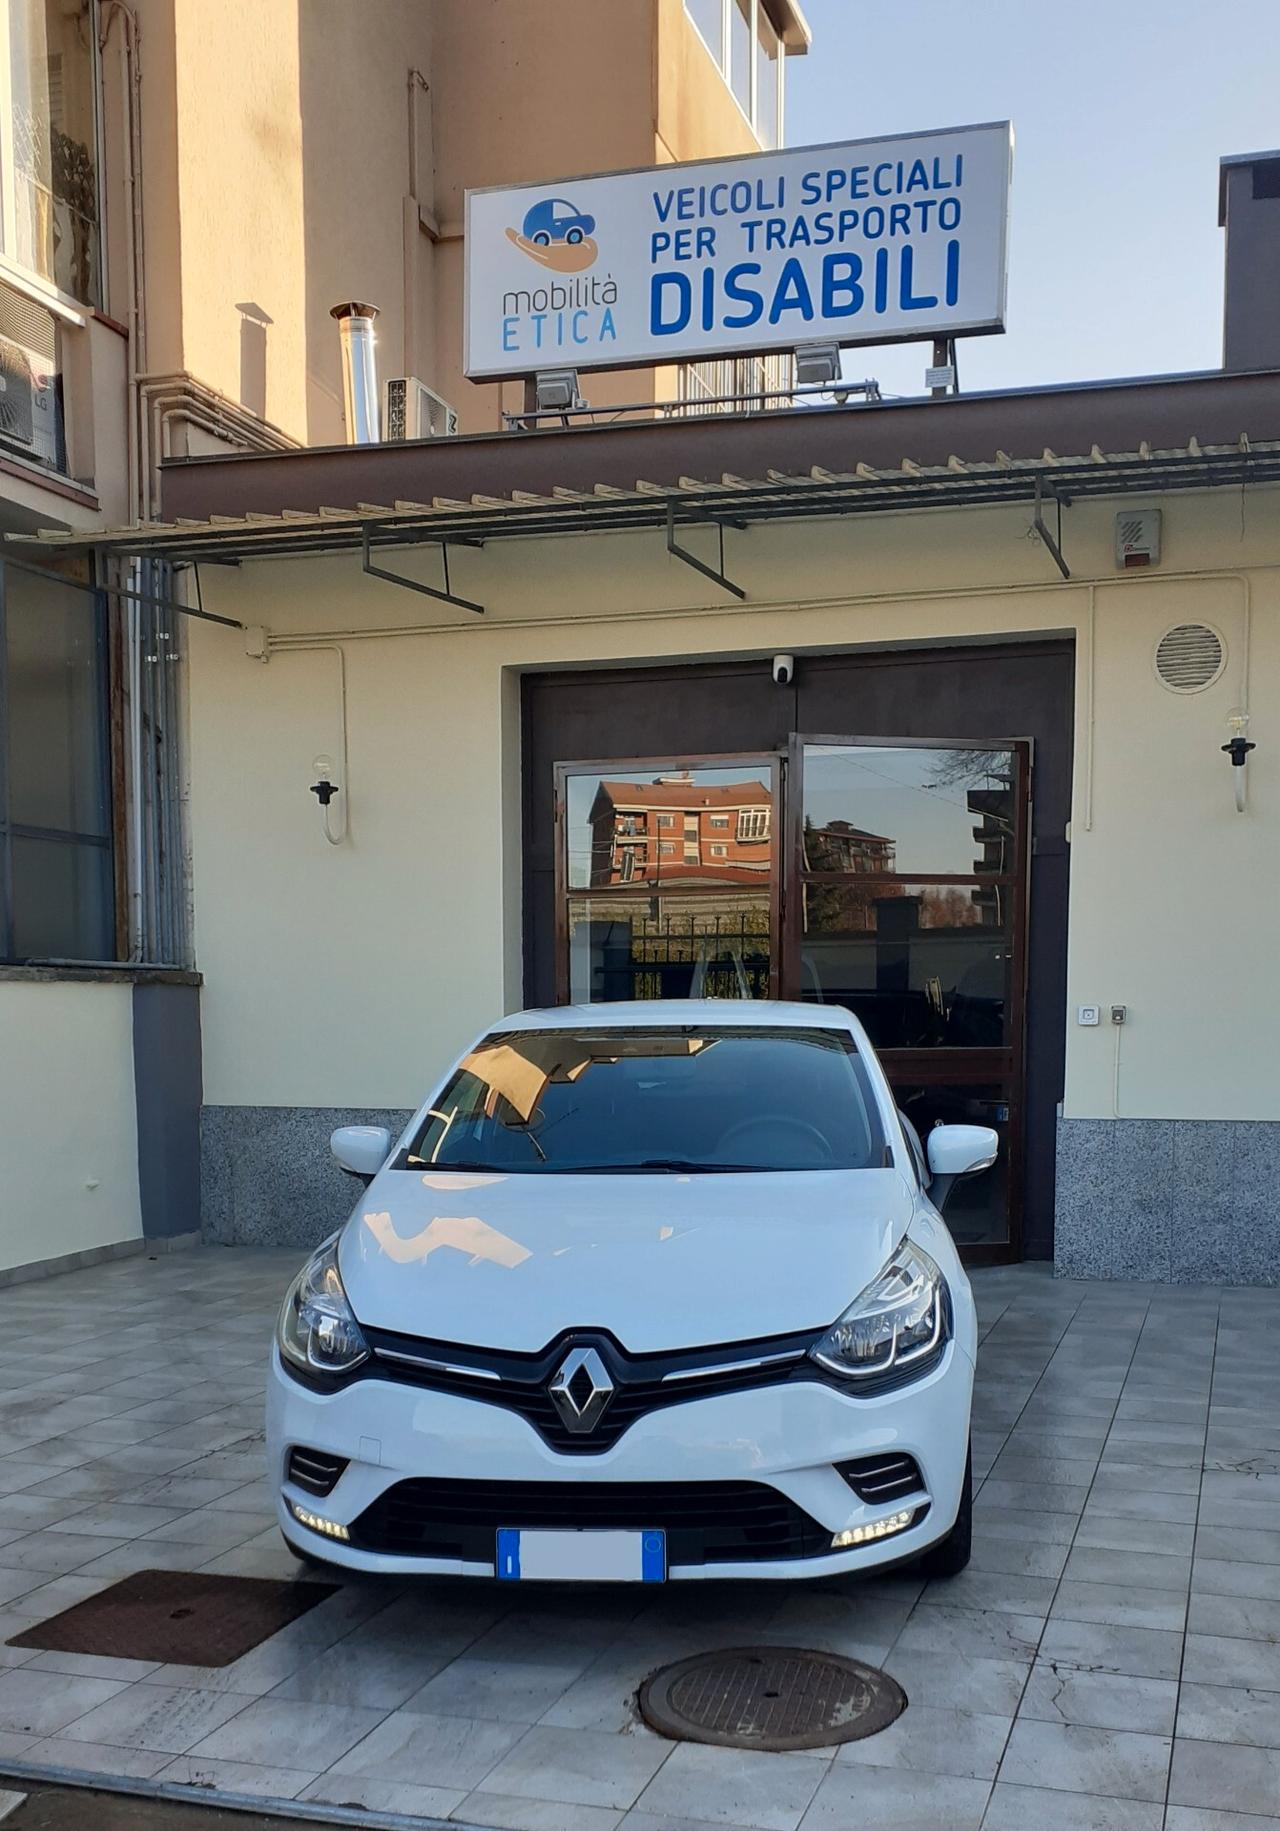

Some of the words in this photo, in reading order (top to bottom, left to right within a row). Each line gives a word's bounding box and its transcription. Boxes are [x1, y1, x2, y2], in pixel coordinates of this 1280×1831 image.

[652, 175, 785, 223] VEICOLI
[800, 153, 964, 206] SPECIALI
[650, 225, 716, 264] PER
[740, 197, 962, 253] TRASPORTO
[503, 272, 618, 316] mobilità
[649, 239, 961, 336] DISABILI
[503, 307, 618, 352] ETICA
[34, 393, 48, 412] LG
